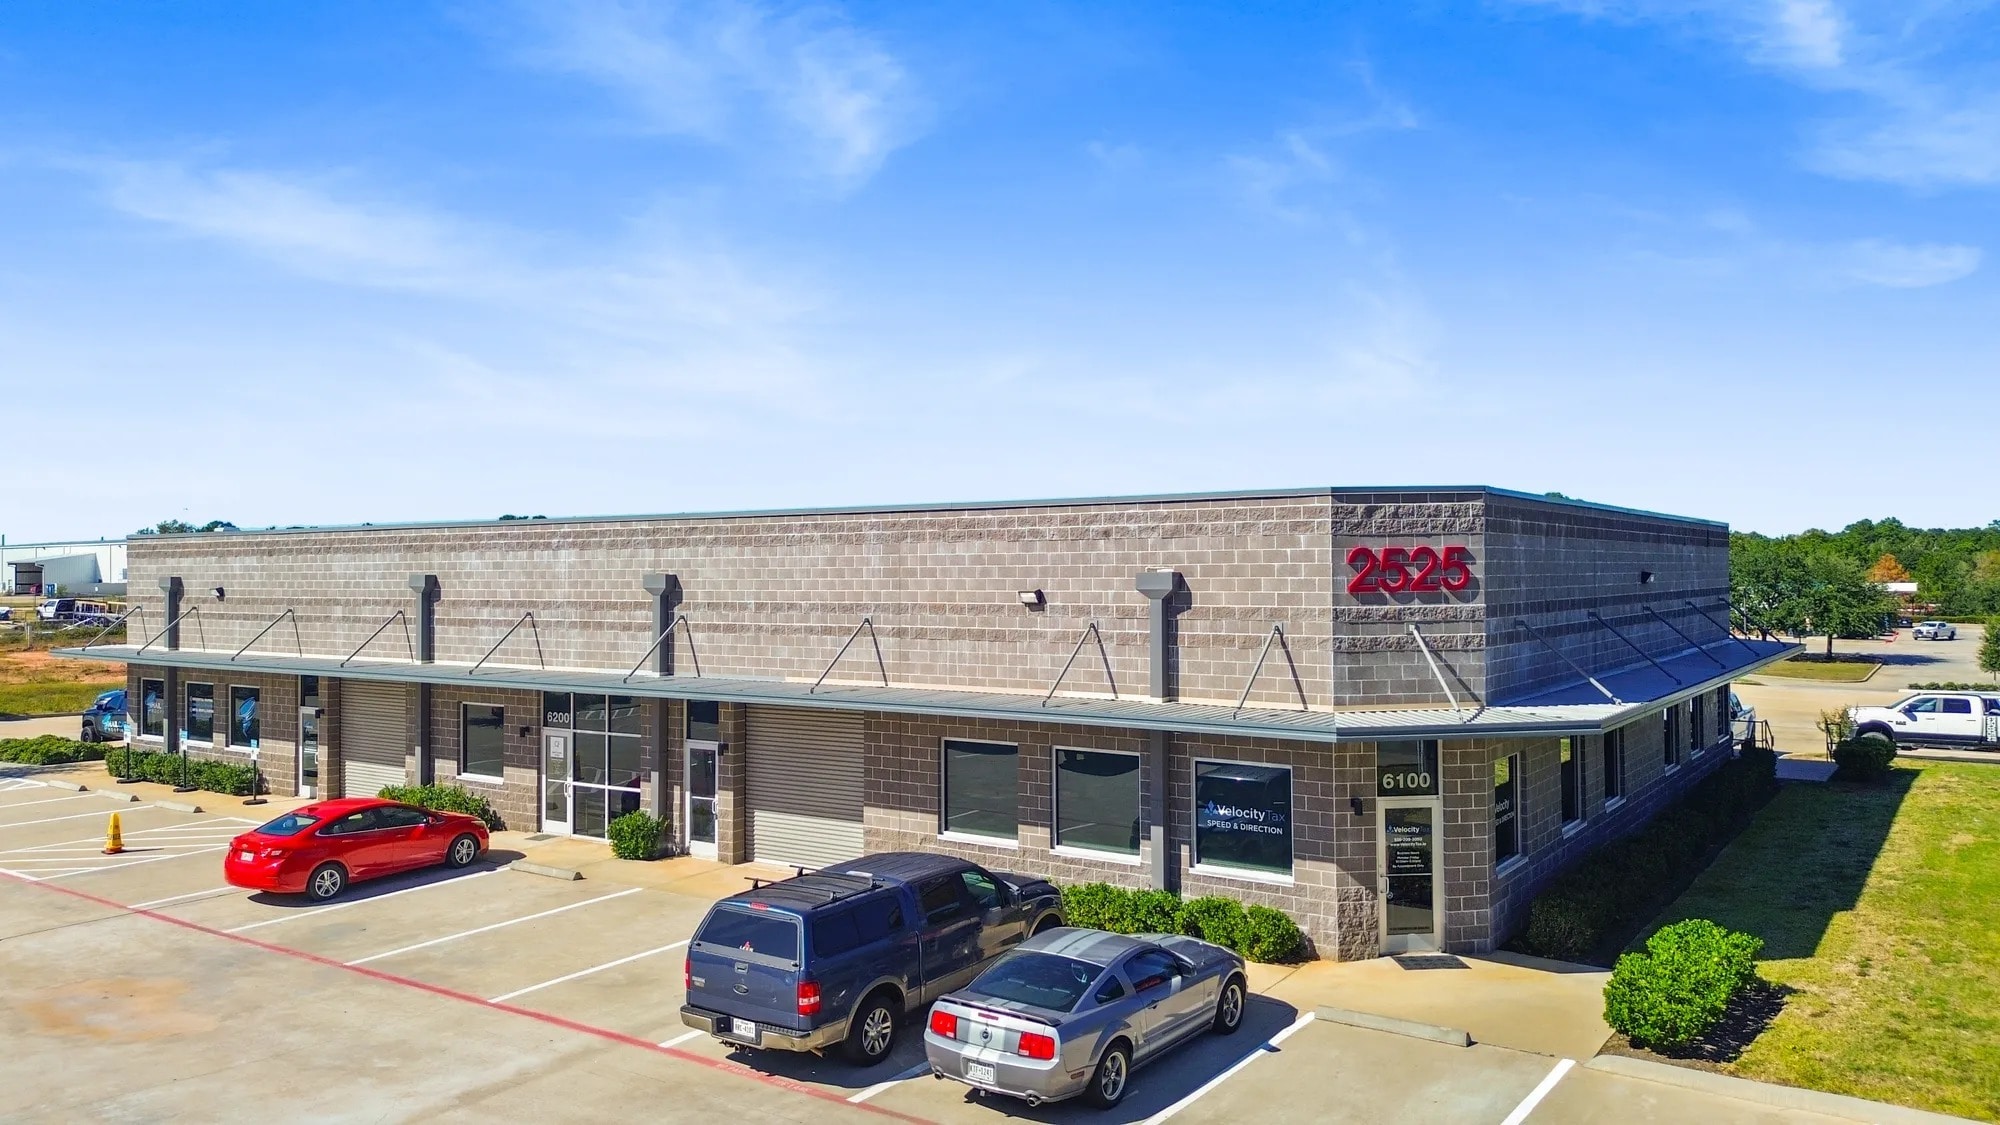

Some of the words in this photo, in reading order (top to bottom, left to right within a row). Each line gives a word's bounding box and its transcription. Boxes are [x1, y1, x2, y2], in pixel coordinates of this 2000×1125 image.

[1347, 546, 1470, 593] 2525
[547, 711, 570, 723] 6200
[1382, 772, 1431, 789] 6100
[1207, 819, 1232, 829] SPEED
[1233, 822, 1239, 830] &
[1240, 823, 1283, 835] DIRECTION
